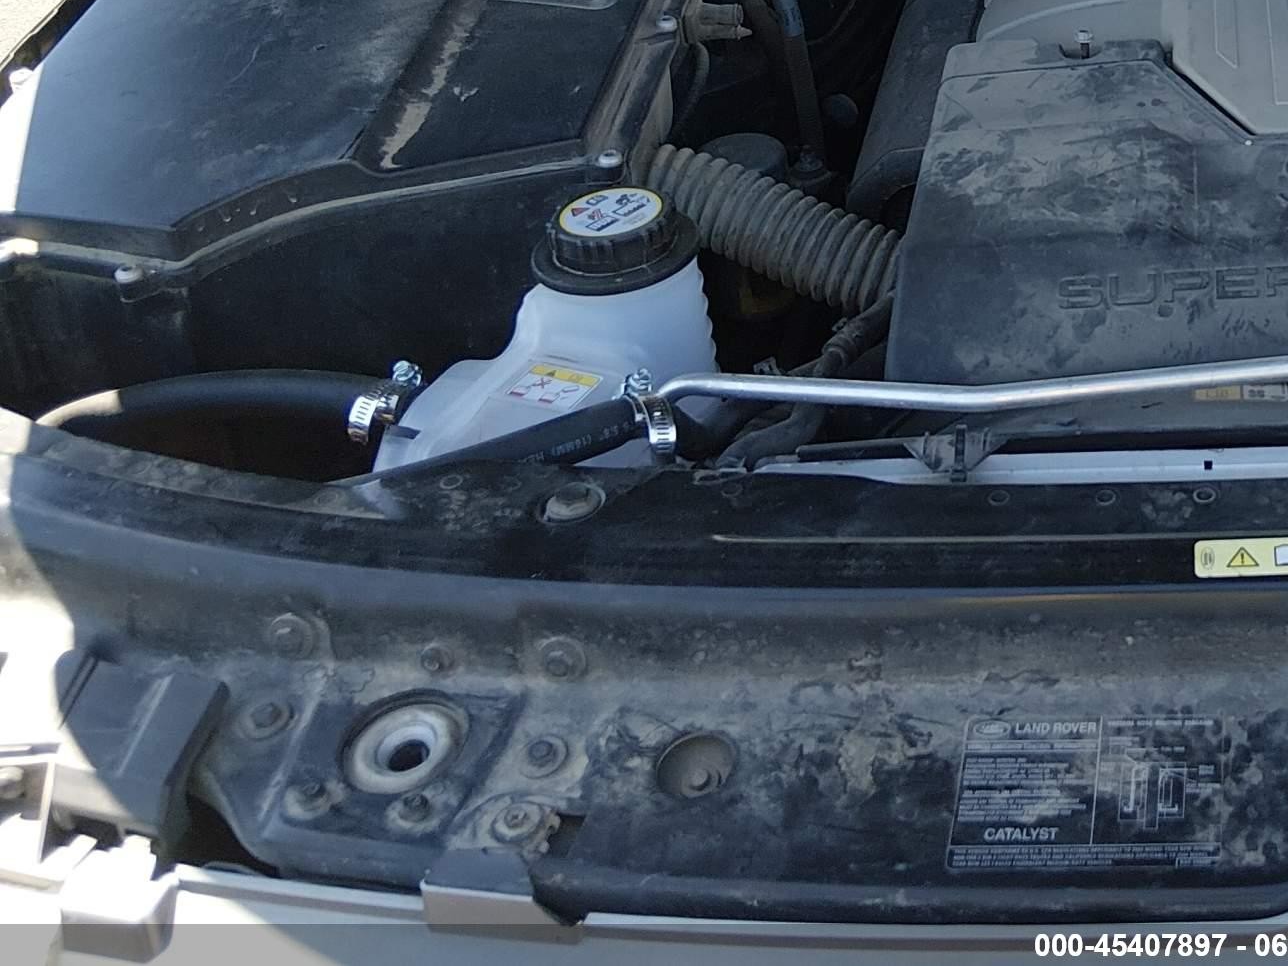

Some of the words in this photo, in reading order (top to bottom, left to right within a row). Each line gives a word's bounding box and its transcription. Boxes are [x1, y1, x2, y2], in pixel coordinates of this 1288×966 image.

[1015, 721, 1051, 734] LAND
[1052, 720, 1097, 734] ROVER
[984, 826, 1059, 842] CATALYST
